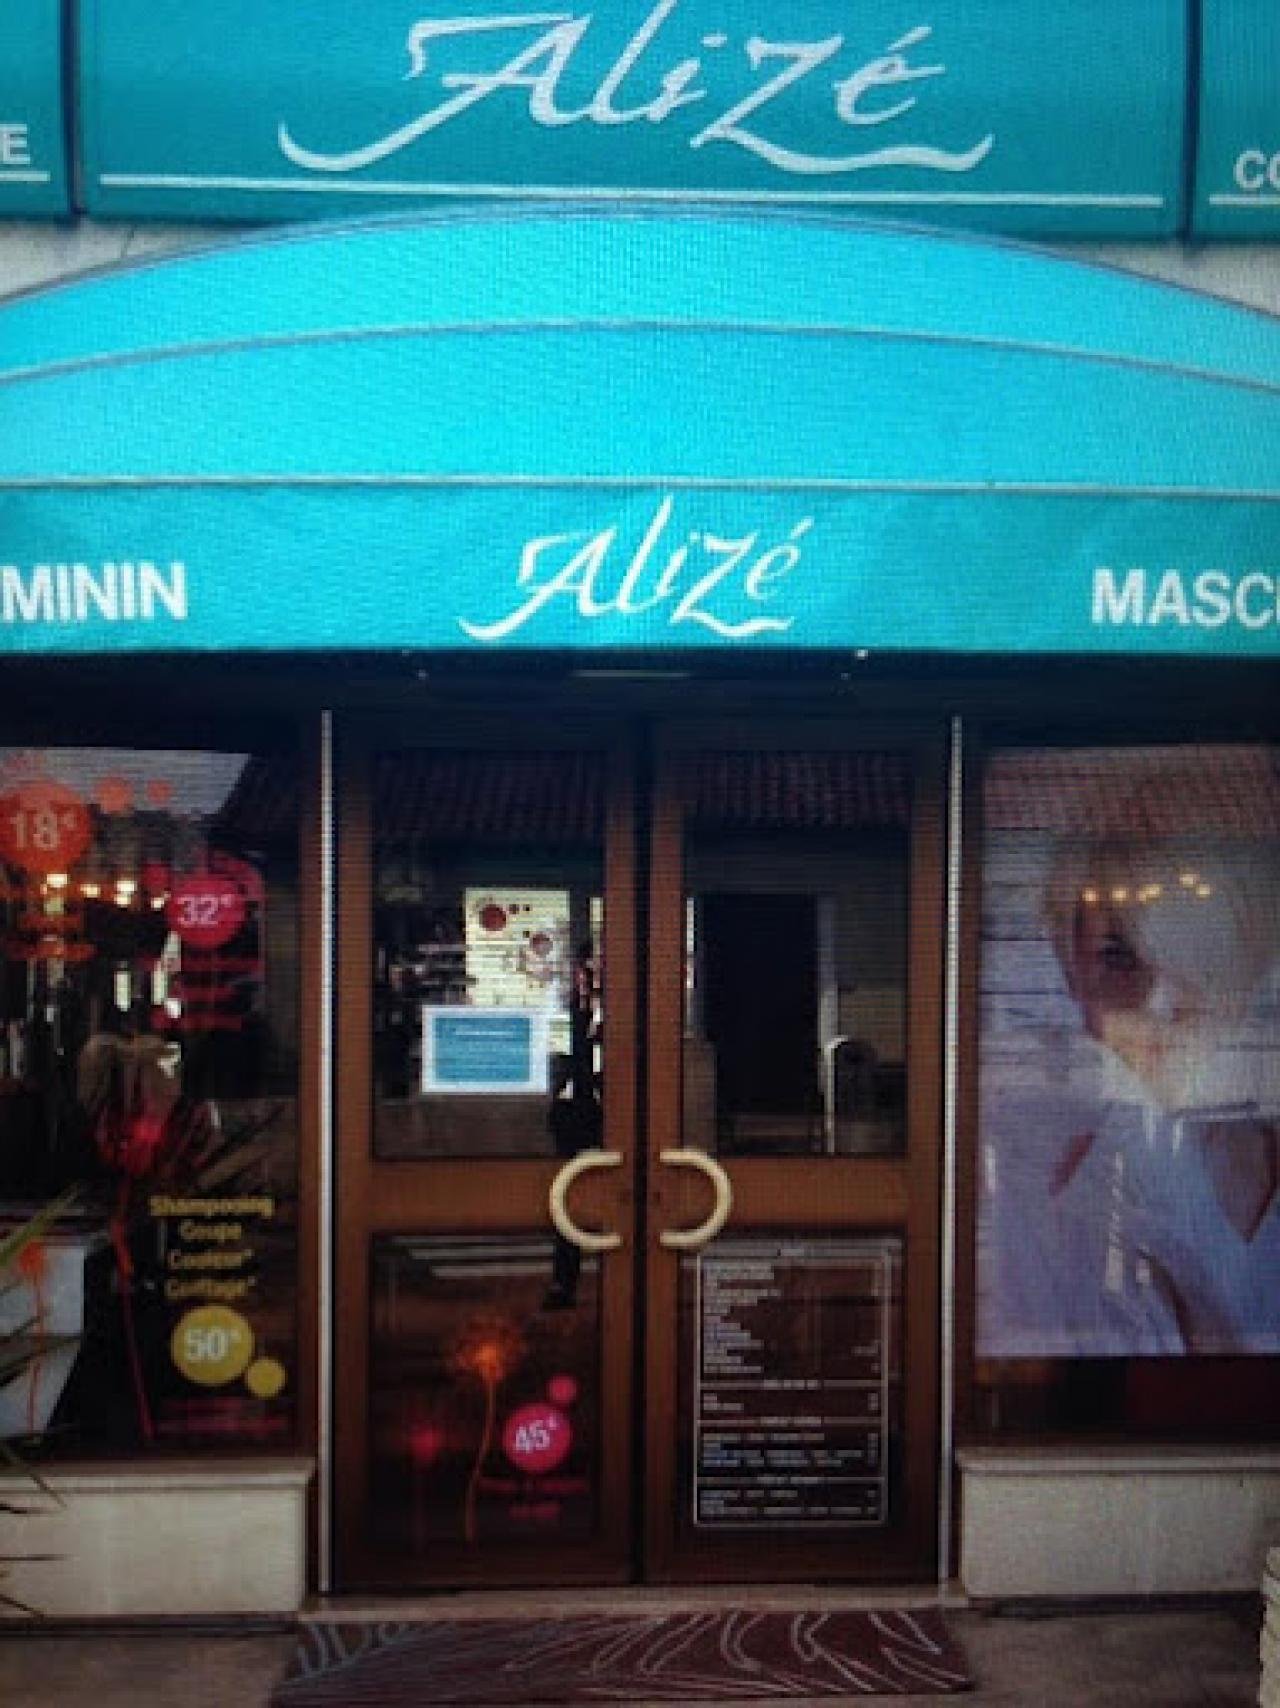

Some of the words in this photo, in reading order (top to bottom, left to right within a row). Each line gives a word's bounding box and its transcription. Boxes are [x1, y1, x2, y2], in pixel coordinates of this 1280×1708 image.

[0, 123, 31, 165] E
[0, 562, 188, 623] MININ
[1092, 568, 1280, 629] MASC
